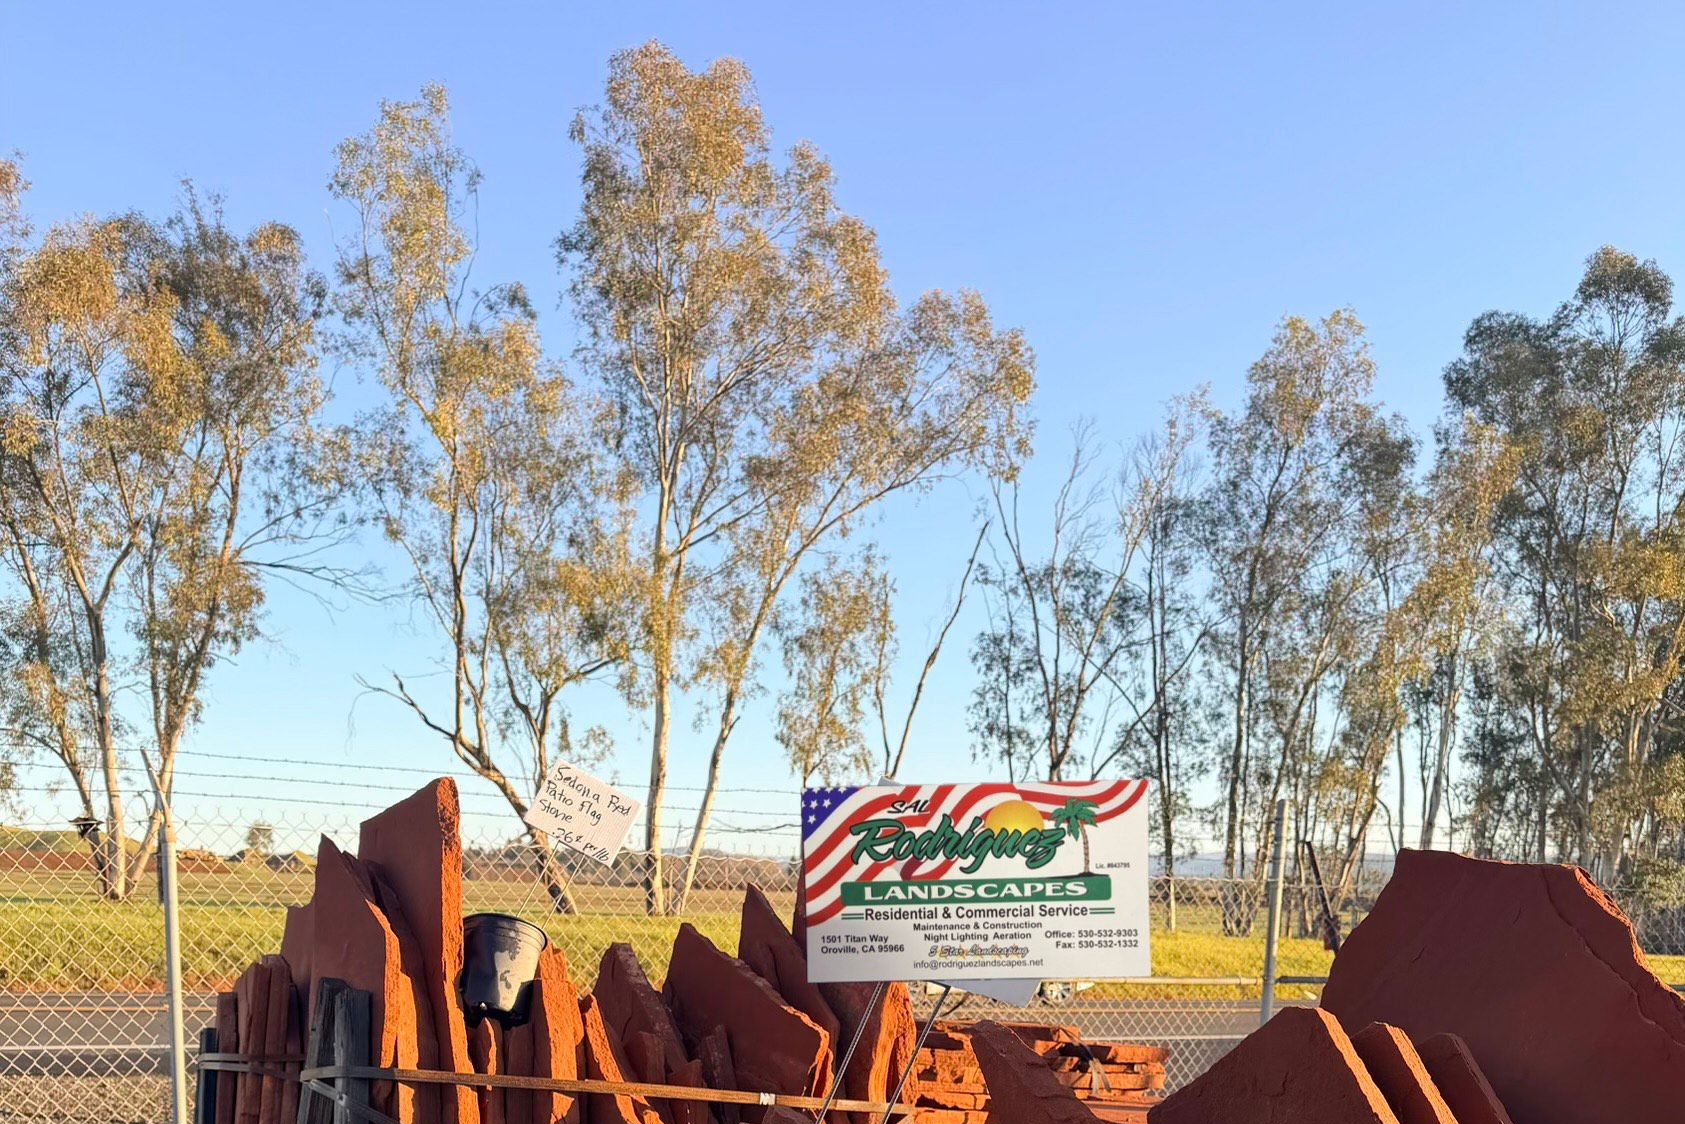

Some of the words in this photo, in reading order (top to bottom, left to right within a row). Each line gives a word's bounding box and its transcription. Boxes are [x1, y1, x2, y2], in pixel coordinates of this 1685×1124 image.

[546, 779, 574, 806] Patio
[555, 766, 601, 803] Sedona
[607, 794, 632, 816] Red
[539, 799, 573, 823] Stone
[887, 799, 930, 814] SAL
[850, 813, 1066, 875] Rodriguez
[863, 881, 1088, 901] LANDSCAPES
[864, 907, 938, 921] Residential
[941, 907, 952, 919] &
[955, 904, 1034, 919] Commercial
[1038, 904, 1088, 917] Service
[913, 923, 971, 931] Maintenance
[982, 920, 1043, 930] Construction
[821, 935, 842, 943] 1501
[845, 935, 868, 943] Titan
[870, 934, 889, 945] Way
[924, 933, 949, 943] Night
[951, 932, 989, 942] Lighting
[993, 931, 1032, 940] Aeration
[1044, 930, 1075, 939] Office:
[1078, 928, 1138, 938] 530-532-9303
[821, 945, 859, 955] Oroville,
[861, 945, 876, 954] CA
[878, 944, 905, 953] 95966
[1056, 940, 1075, 949] Fax:
[1078, 939, 1139, 949] 530-532-1332
[913, 958, 1044, 970] info@rodriguezlandscapes.net
